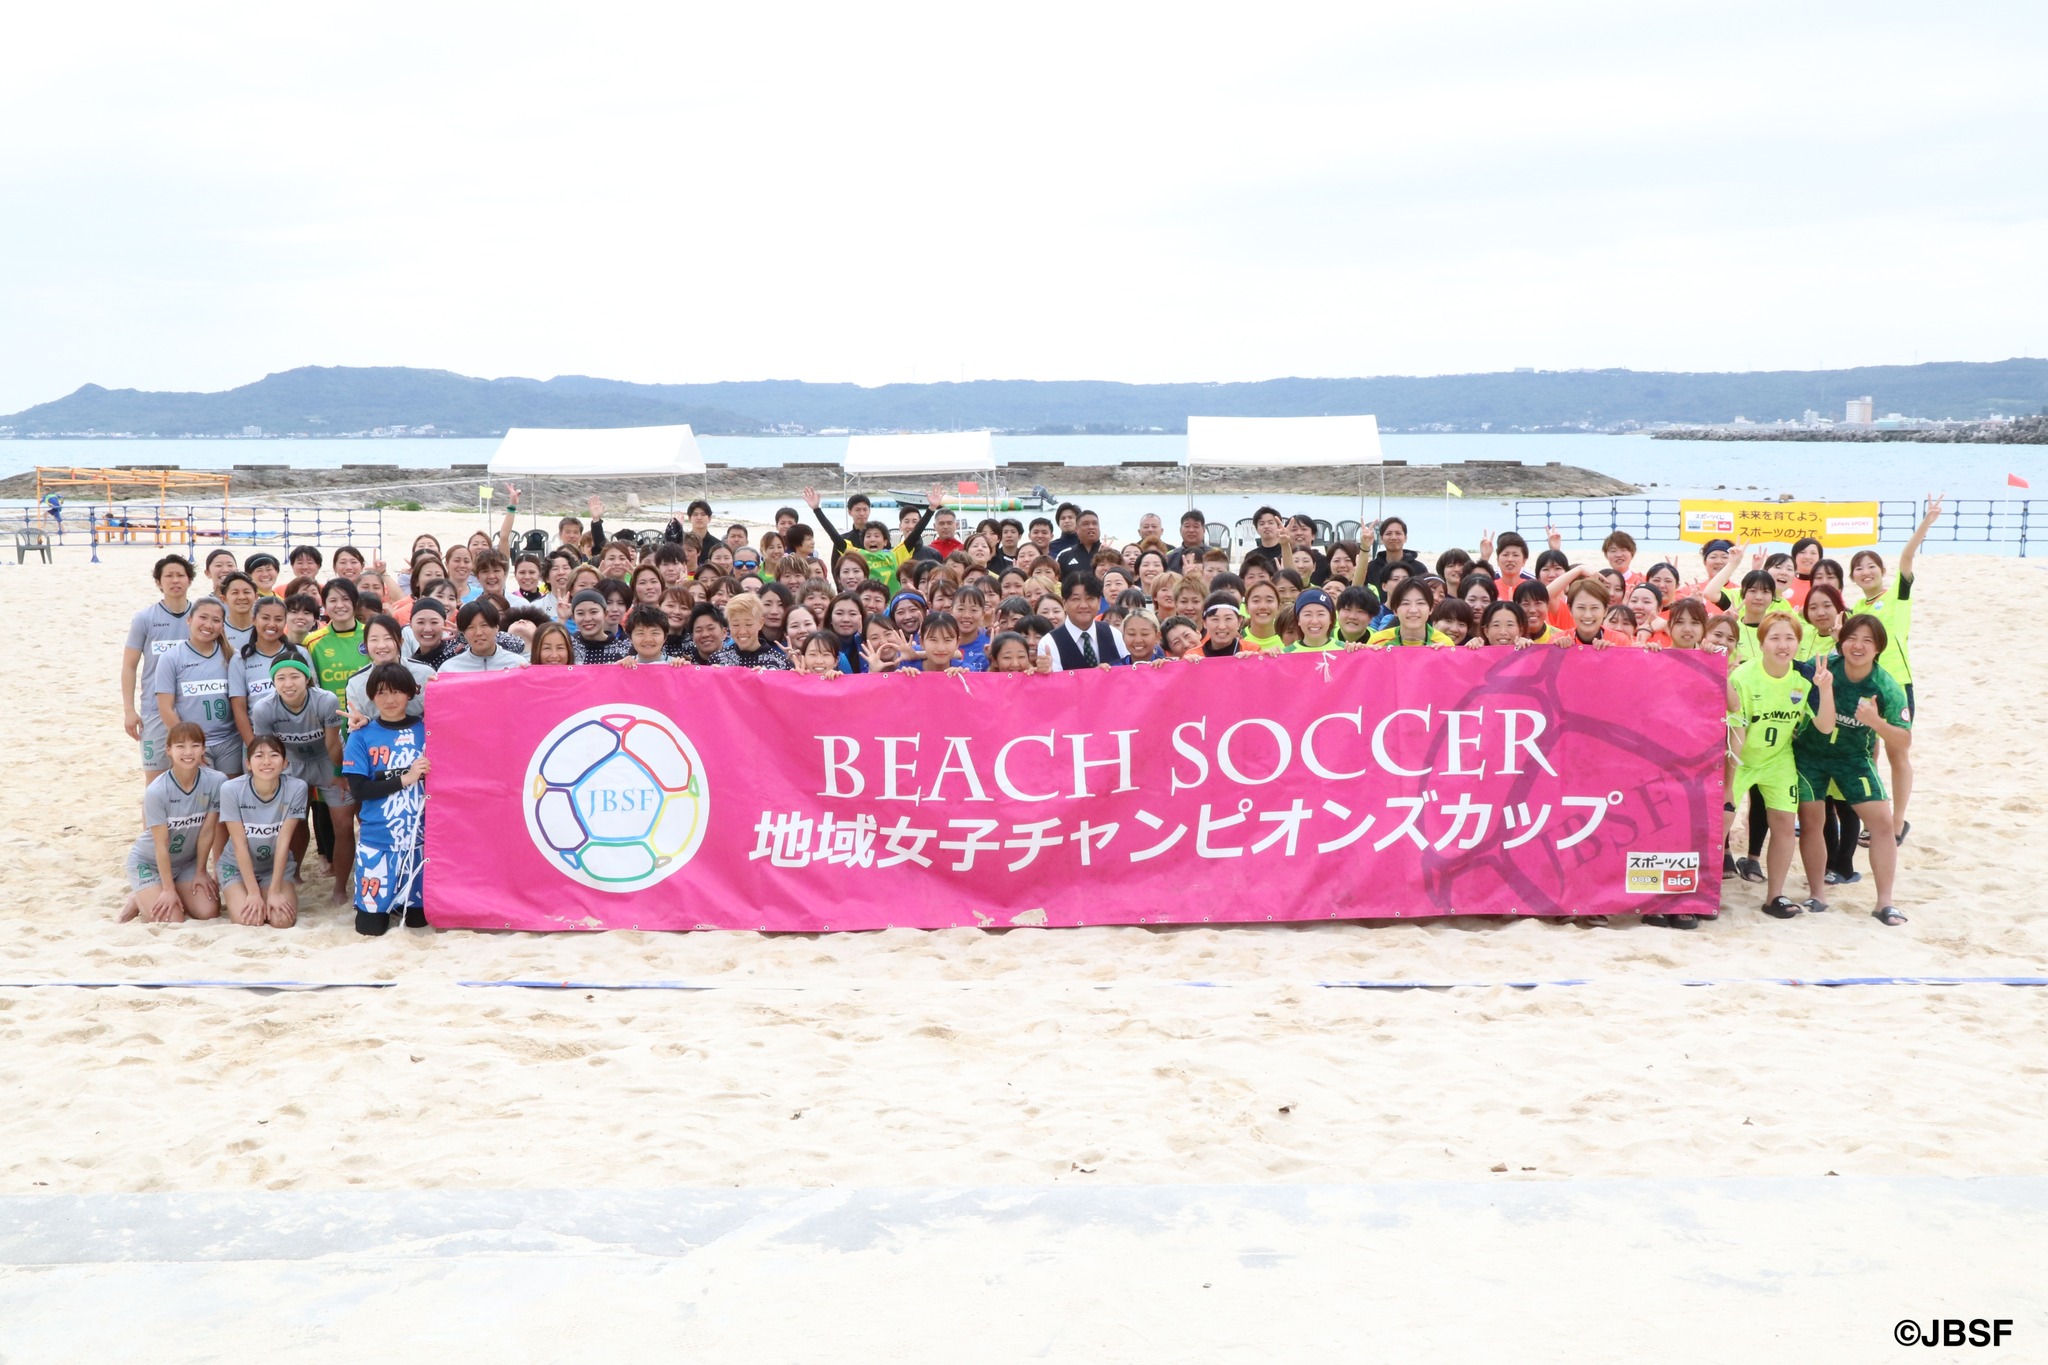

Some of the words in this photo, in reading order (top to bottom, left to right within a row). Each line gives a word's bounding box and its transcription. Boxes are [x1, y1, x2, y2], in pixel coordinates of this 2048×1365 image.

[1739, 510, 1822, 521] 未来を育てよう、
[202, 698, 227, 720] 19
[1765, 727, 1778, 747] 9
[143, 741, 154, 760] 5
[815, 729, 1139, 806] BEACH
[1172, 704, 1557, 796] SOCCER
[1859, 776, 1872, 797] 1
[587, 787, 654, 819] JBSF
[749, 791, 1623, 871] 地域女子チャンピオンズカップ
[169, 834, 185, 853] 2
[256, 845, 271, 862] 3
[1630, 855, 1697, 869] スポーツくじ
[137, 863, 152, 878] 2
